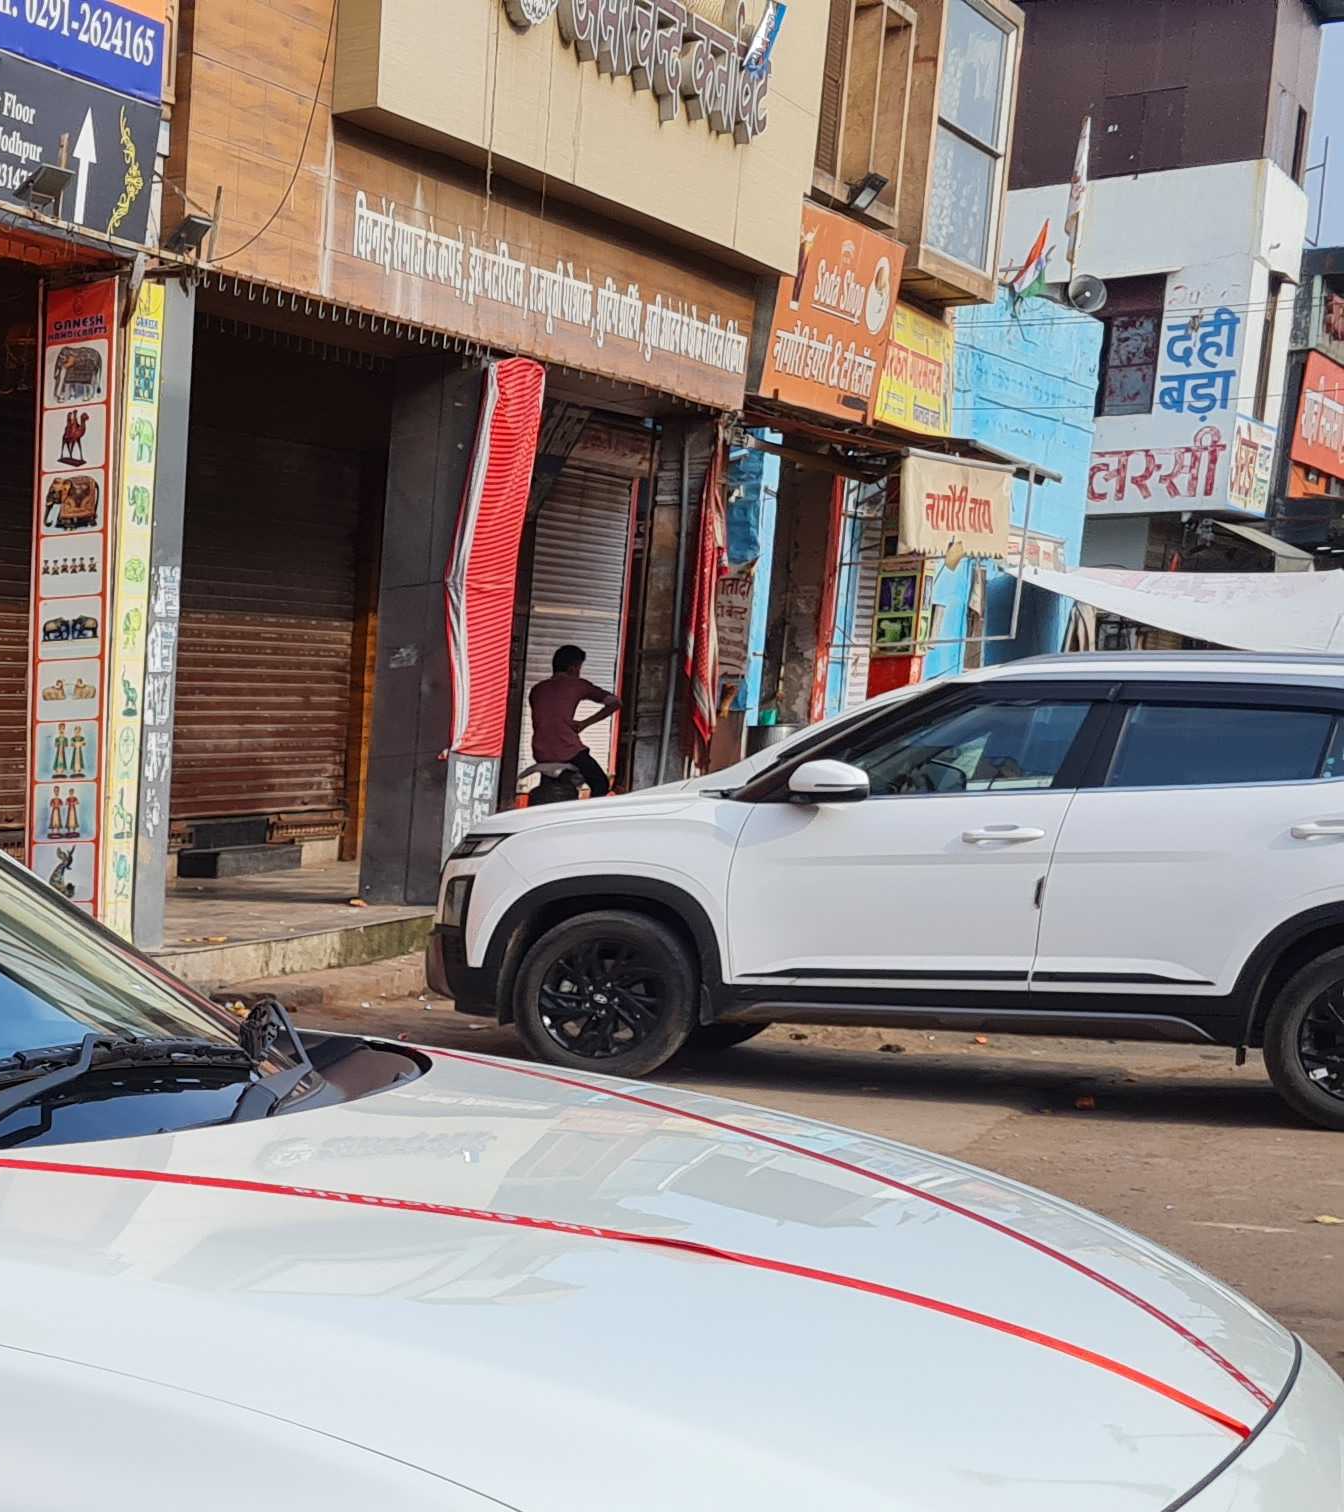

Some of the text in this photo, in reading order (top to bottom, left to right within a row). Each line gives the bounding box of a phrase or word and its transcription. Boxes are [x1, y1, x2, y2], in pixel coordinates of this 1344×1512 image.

[25, 0, 155, 66] 0291-2624165
[3, 92, 36, 125] Floor
[814, 259, 865, 316] Soda Shop
[54, 314, 103, 331] GANESH
[1166, 306, 1241, 368] दही
[828, 341, 842, 388] &
[1158, 369, 1236, 423] बड़ा
[1087, 426, 1227, 502] लस्सी
[925, 484, 969, 533] नागौरी
